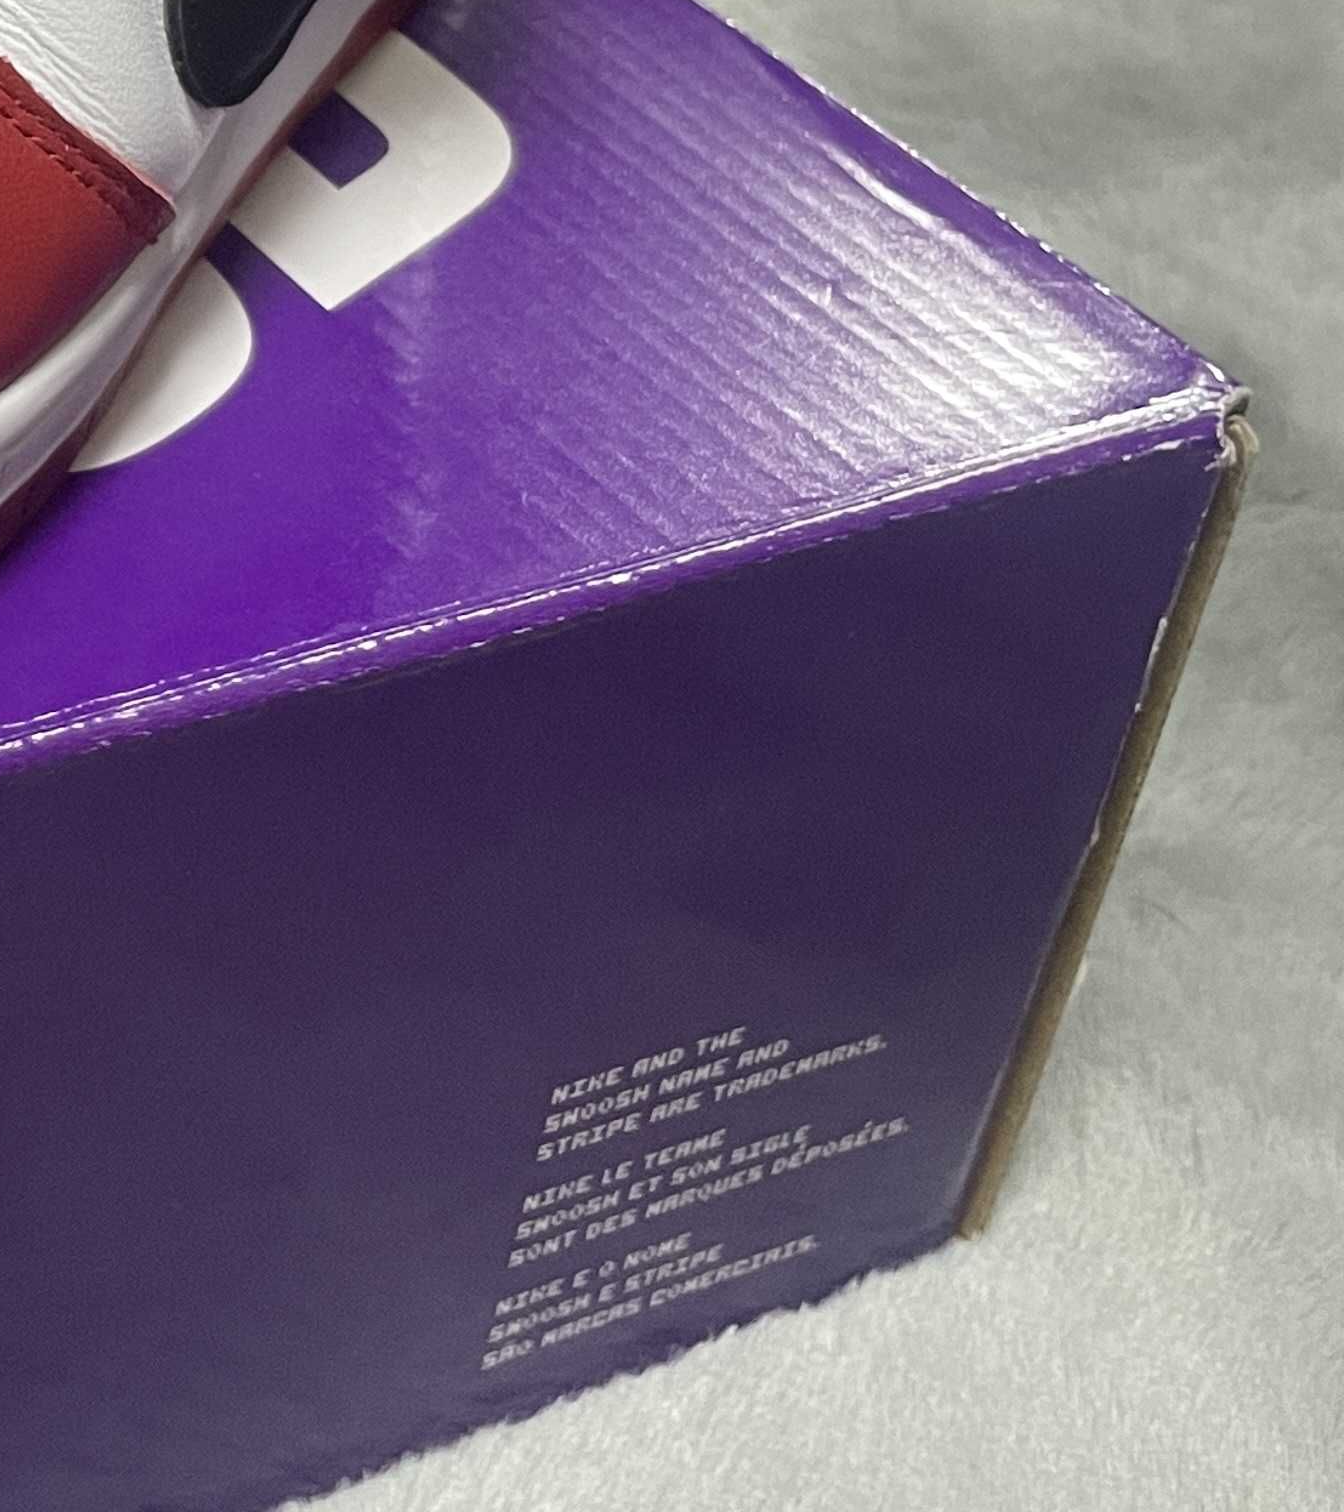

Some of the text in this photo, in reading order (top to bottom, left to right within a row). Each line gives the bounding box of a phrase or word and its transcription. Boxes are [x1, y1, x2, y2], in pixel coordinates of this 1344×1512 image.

[536, 1034, 888, 1162] STRIPE ARE TRADEMARKS.
[550, 1026, 747, 1105] NIKE AND THE
[658, 1058, 729, 1096] NAME
[738, 1039, 790, 1069] AND
[522, 1129, 727, 1213] NIKE LE TERME
[628, 1177, 659, 1201] ET
[669, 1158, 722, 1186] SON
[730, 1125, 811, 1165] SIGLE
[507, 1235, 576, 1268] SONT
[585, 1211, 636, 1240] DES
[645, 1168, 764, 1218] MARQUES
[495, 1278, 563, 1316] NIKE
[573, 1267, 593, 1288] E
[624, 1232, 692, 1271] NOME
[597, 1280, 618, 1303] E
[624, 1244, 724, 1293] STRIPE
[541, 1299, 641, 1348] MARCAS
